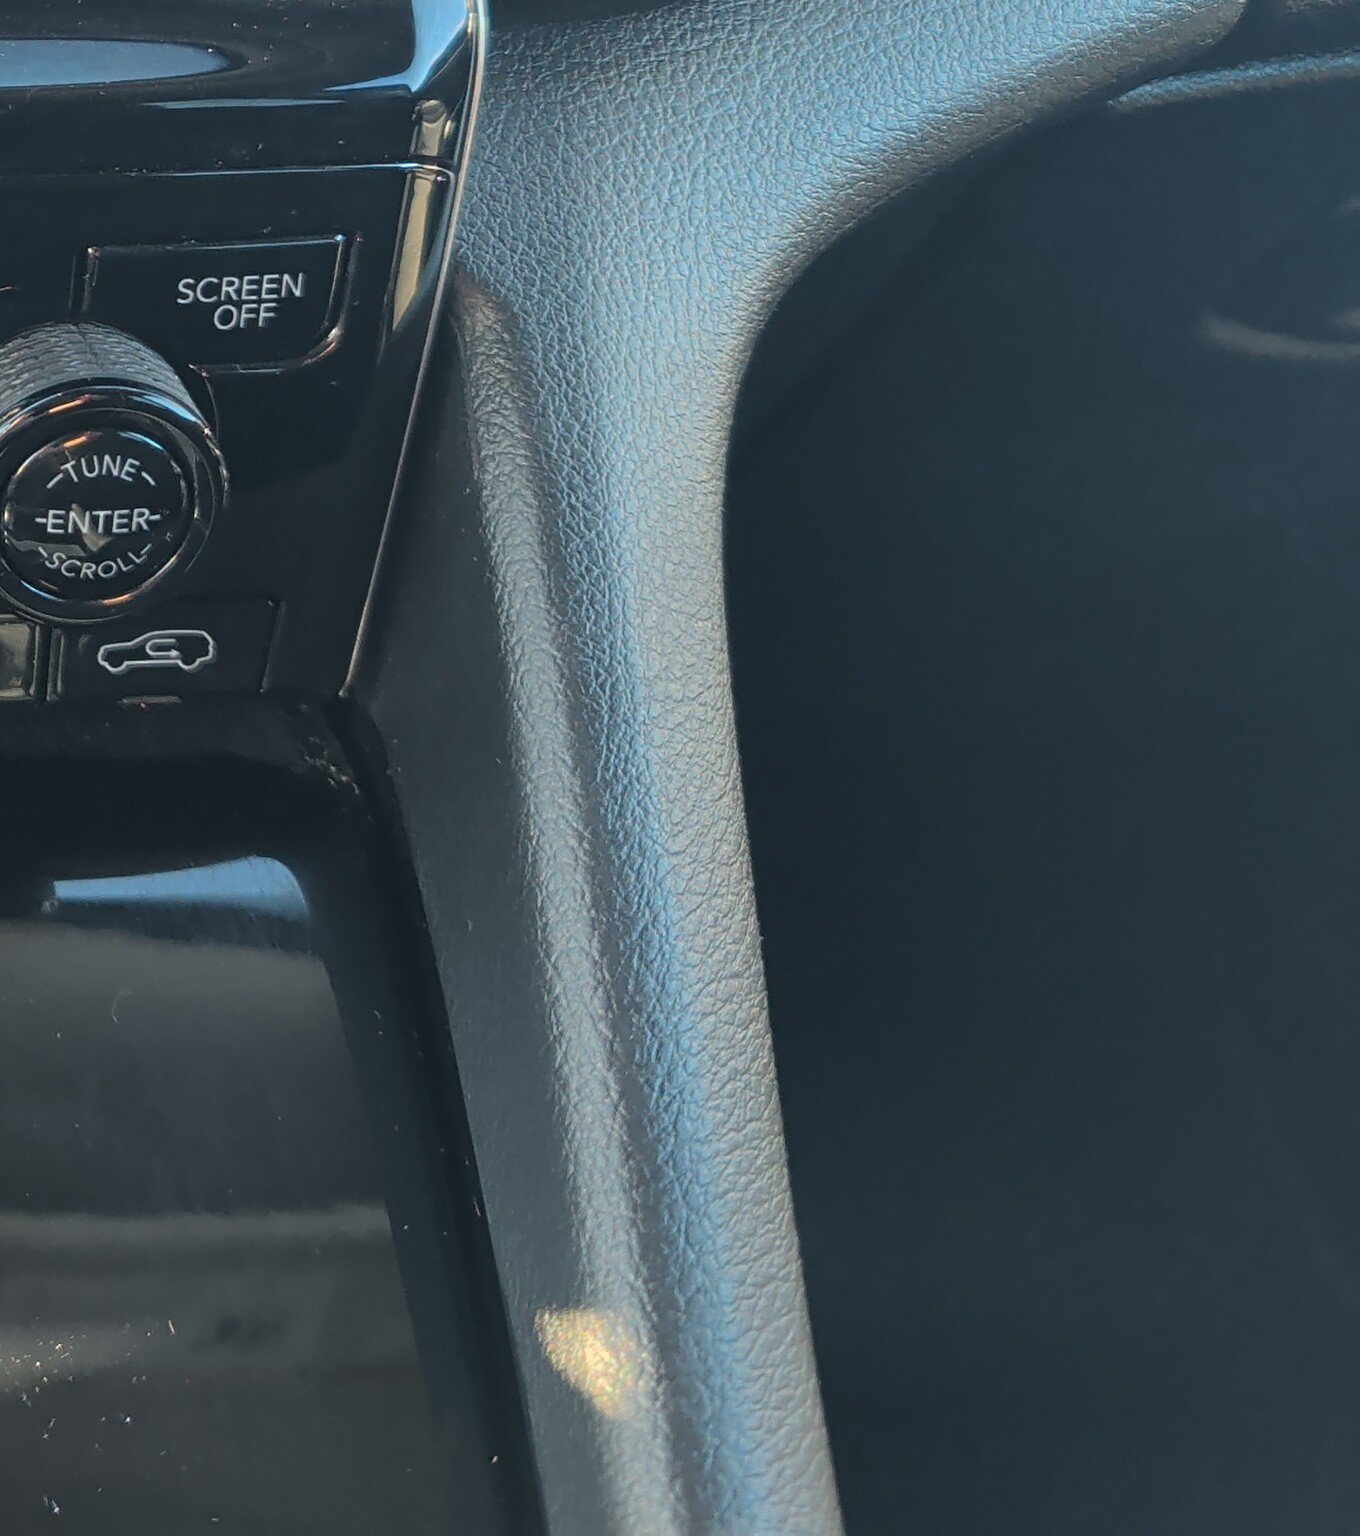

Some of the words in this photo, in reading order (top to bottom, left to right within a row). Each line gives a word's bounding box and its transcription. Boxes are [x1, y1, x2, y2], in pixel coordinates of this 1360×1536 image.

[176, 272, 304, 305] SCREEN
[213, 302, 277, 331] OFF
[60, 454, 140, 483] TUNE
[45, 507, 151, 535] ENTER
[44, 551, 148, 579] SCROLL
